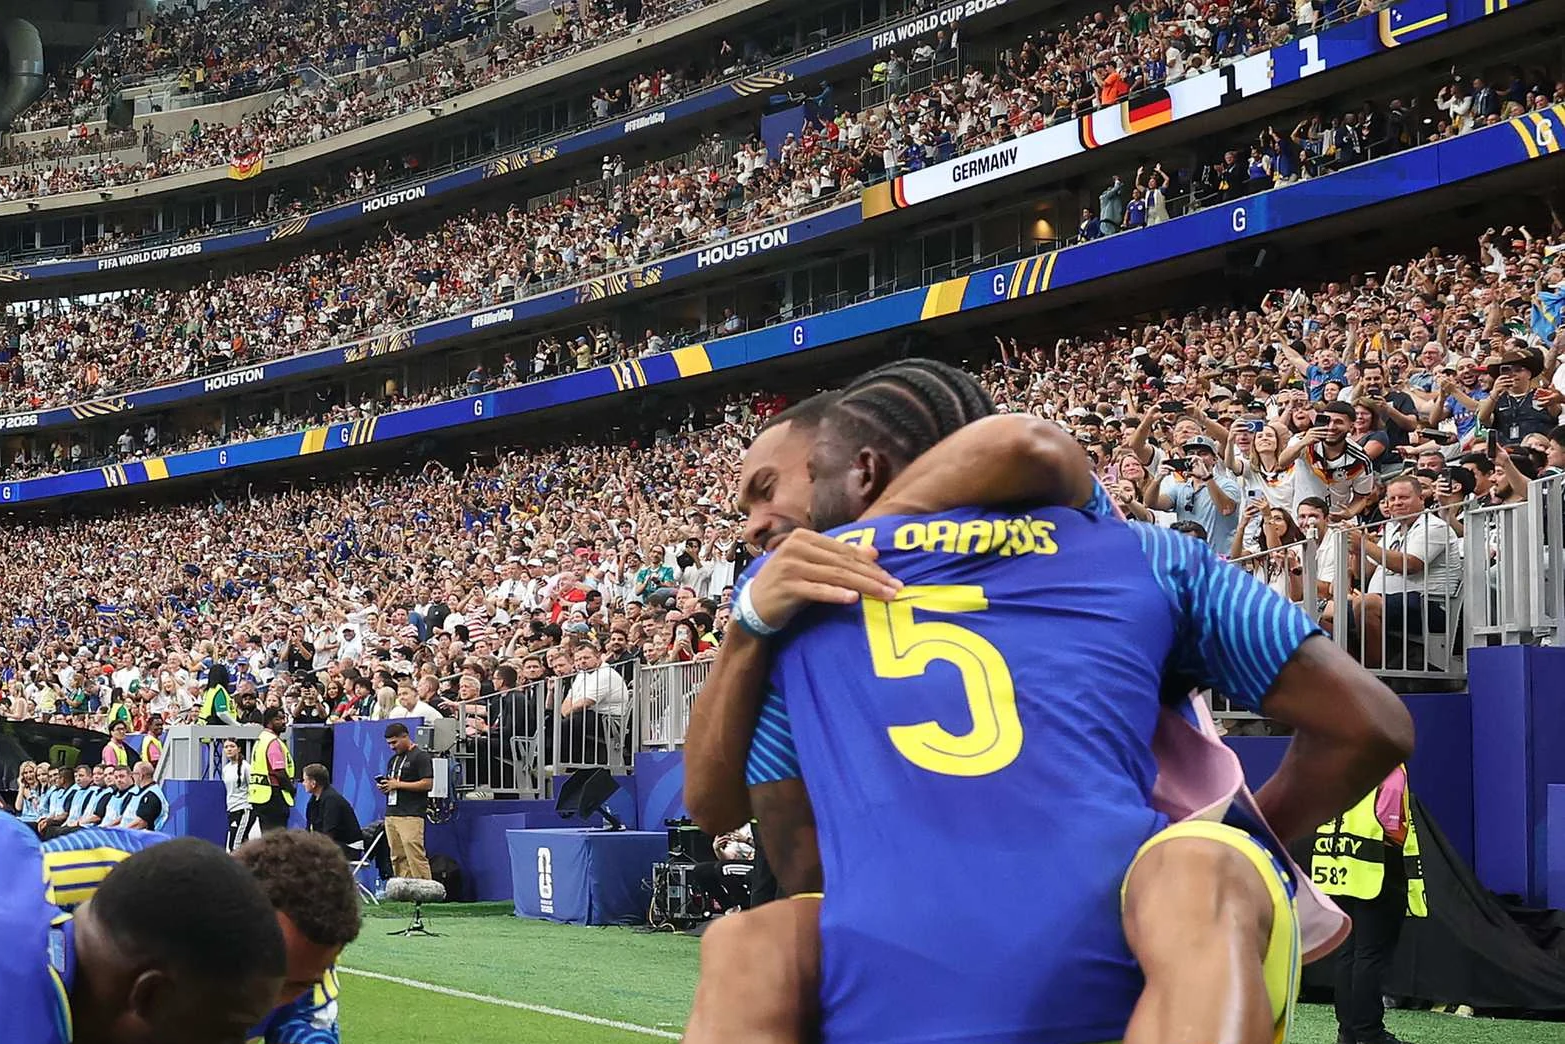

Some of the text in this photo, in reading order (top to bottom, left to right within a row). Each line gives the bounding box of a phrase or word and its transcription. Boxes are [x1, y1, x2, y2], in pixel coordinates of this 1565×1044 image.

[872, 33, 897, 51] FIFA
[897, 15, 939, 41] WORLD
[940, 5, 964, 25] CUP
[1299, 35, 1326, 78] 1
[952, 146, 1019, 183] GERMANY
[362, 185, 426, 213] HOUSTON
[1232, 207, 1246, 232] G
[98, 243, 202, 270] FIFA WORLD CUP 2026
[697, 228, 788, 268] HOUSTON
[993, 273, 1005, 296] G
[793, 325, 803, 346] G
[204, 367, 264, 392] HOUSTON
[6, 415, 38, 428] 2026
[862, 584, 1023, 777] 5
